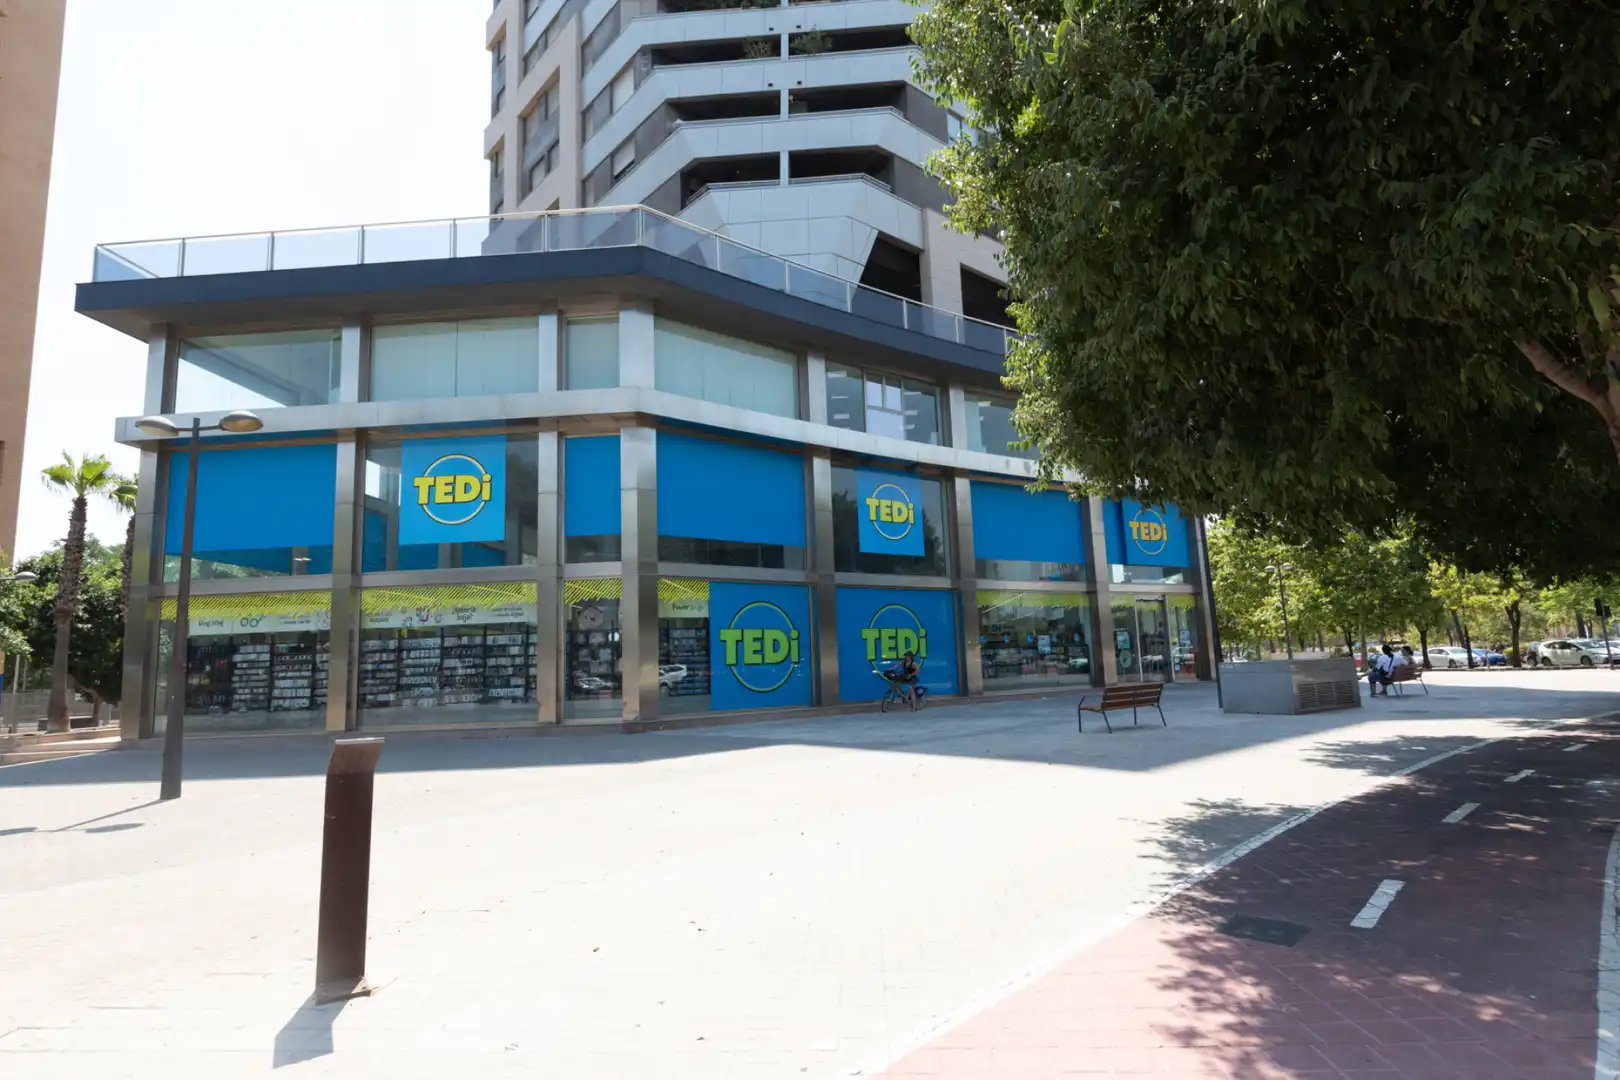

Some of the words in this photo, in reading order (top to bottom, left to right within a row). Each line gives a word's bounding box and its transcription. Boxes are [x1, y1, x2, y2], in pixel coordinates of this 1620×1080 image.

[413, 473, 492, 505] TEDi
[865, 497, 915, 525] TEDi
[1128, 520, 1168, 542] TEDi
[719, 628, 800, 667] TEDi
[861, 628, 927, 661] TEDi
